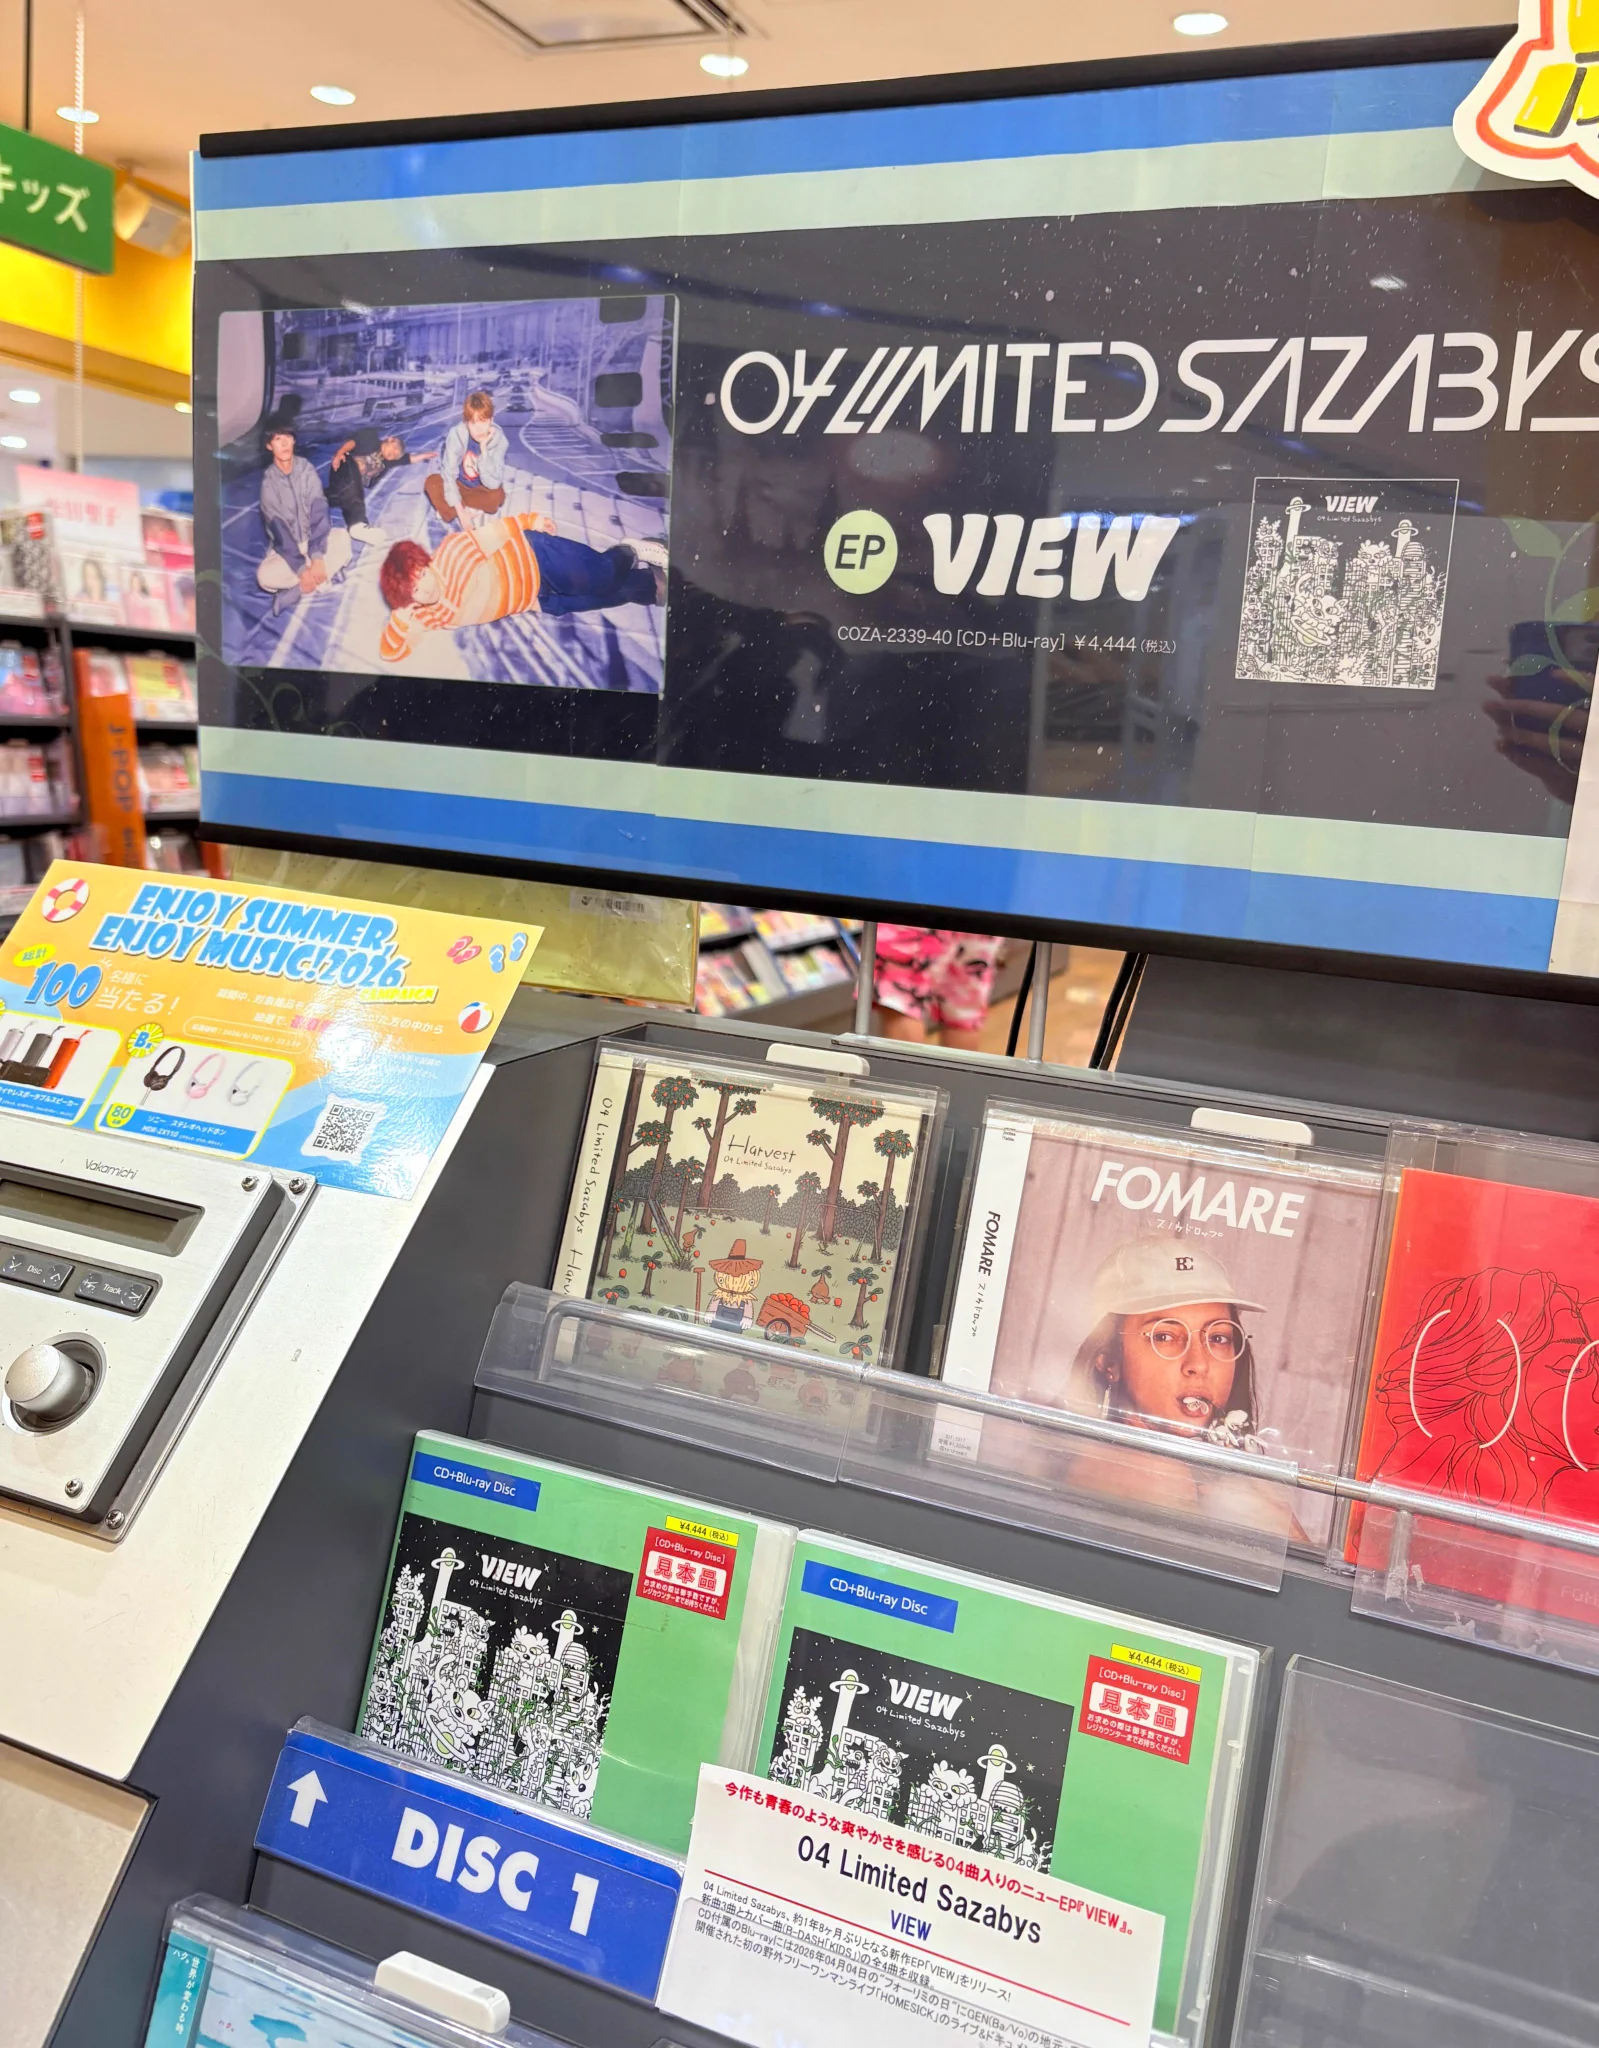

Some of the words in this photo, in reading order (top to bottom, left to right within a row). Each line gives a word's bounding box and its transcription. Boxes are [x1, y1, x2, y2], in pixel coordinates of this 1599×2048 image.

[823, 341, 1159, 434] LIMITED
[1325, 496, 1378, 513] VIEW
[835, 534, 885, 570] EP
[922, 513, 1181, 601] VIEW
[837, 626, 952, 645] COZA-2339-40
[1074, 635, 1137, 652] ¥4,444
[92, 915, 208, 961] ENJOY
[129, 884, 244, 933] ENJOY
[239, 900, 396, 958] SUMMER,
[25, 961, 102, 1007] 100
[110, 970, 148, 986] 名様に
[134, 1031, 152, 1049] B.
[111, 1105, 132, 1119] 80
[589, 1123, 608, 1175] Limited
[727, 1134, 796, 1163] Harvest
[736, 1157, 762, 1168] Limited
[764, 1162, 792, 1175] Sazabys
[574, 1178, 597, 1234] Sazabys
[1091, 1160, 1305, 1238] FOMARE
[978, 1210, 1001, 1276] FOMARE
[26, 1264, 43, 1275] Disc
[564, 1249, 583, 1294] Harv
[103, 1283, 121, 1295] Track
[433, 1466, 491, 1493] CD+Blu-ray
[493, 1481, 516, 1497] Disc
[680, 1521, 707, 1537] ¥4,444
[481, 1554, 542, 1591] VIEW
[654, 1556, 716, 1591] 見本品
[704, 1550, 726, 1564] Disc]
[469, 1579, 480, 1588] 04
[481, 1582, 507, 1596] Limited
[508, 1589, 543, 1609] Sazabys
[829, 1577, 899, 1610] CD+Blu-ray
[901, 1597, 928, 1615] Disc
[1128, 1651, 1162, 1668] ¥4,444
[889, 1678, 963, 1721] VIEW
[1098, 1688, 1177, 1731] 見本品
[1160, 1685, 1186, 1701] Disc]
[876, 1706, 888, 1716] 04
[889, 1710, 922, 1726] Limited
[923, 1719, 966, 1742] Sazabys
[391, 1806, 540, 1912] DISC
[569, 1872, 600, 1937] 1
[703, 1880, 715, 1893] 04
[716, 1884, 748, 1906] Limited
[798, 1835, 830, 1869] 04
[840, 1849, 928, 1904] Limited
[937, 1884, 1042, 1944] Sazabys
[890, 1909, 932, 1941] VIEW
